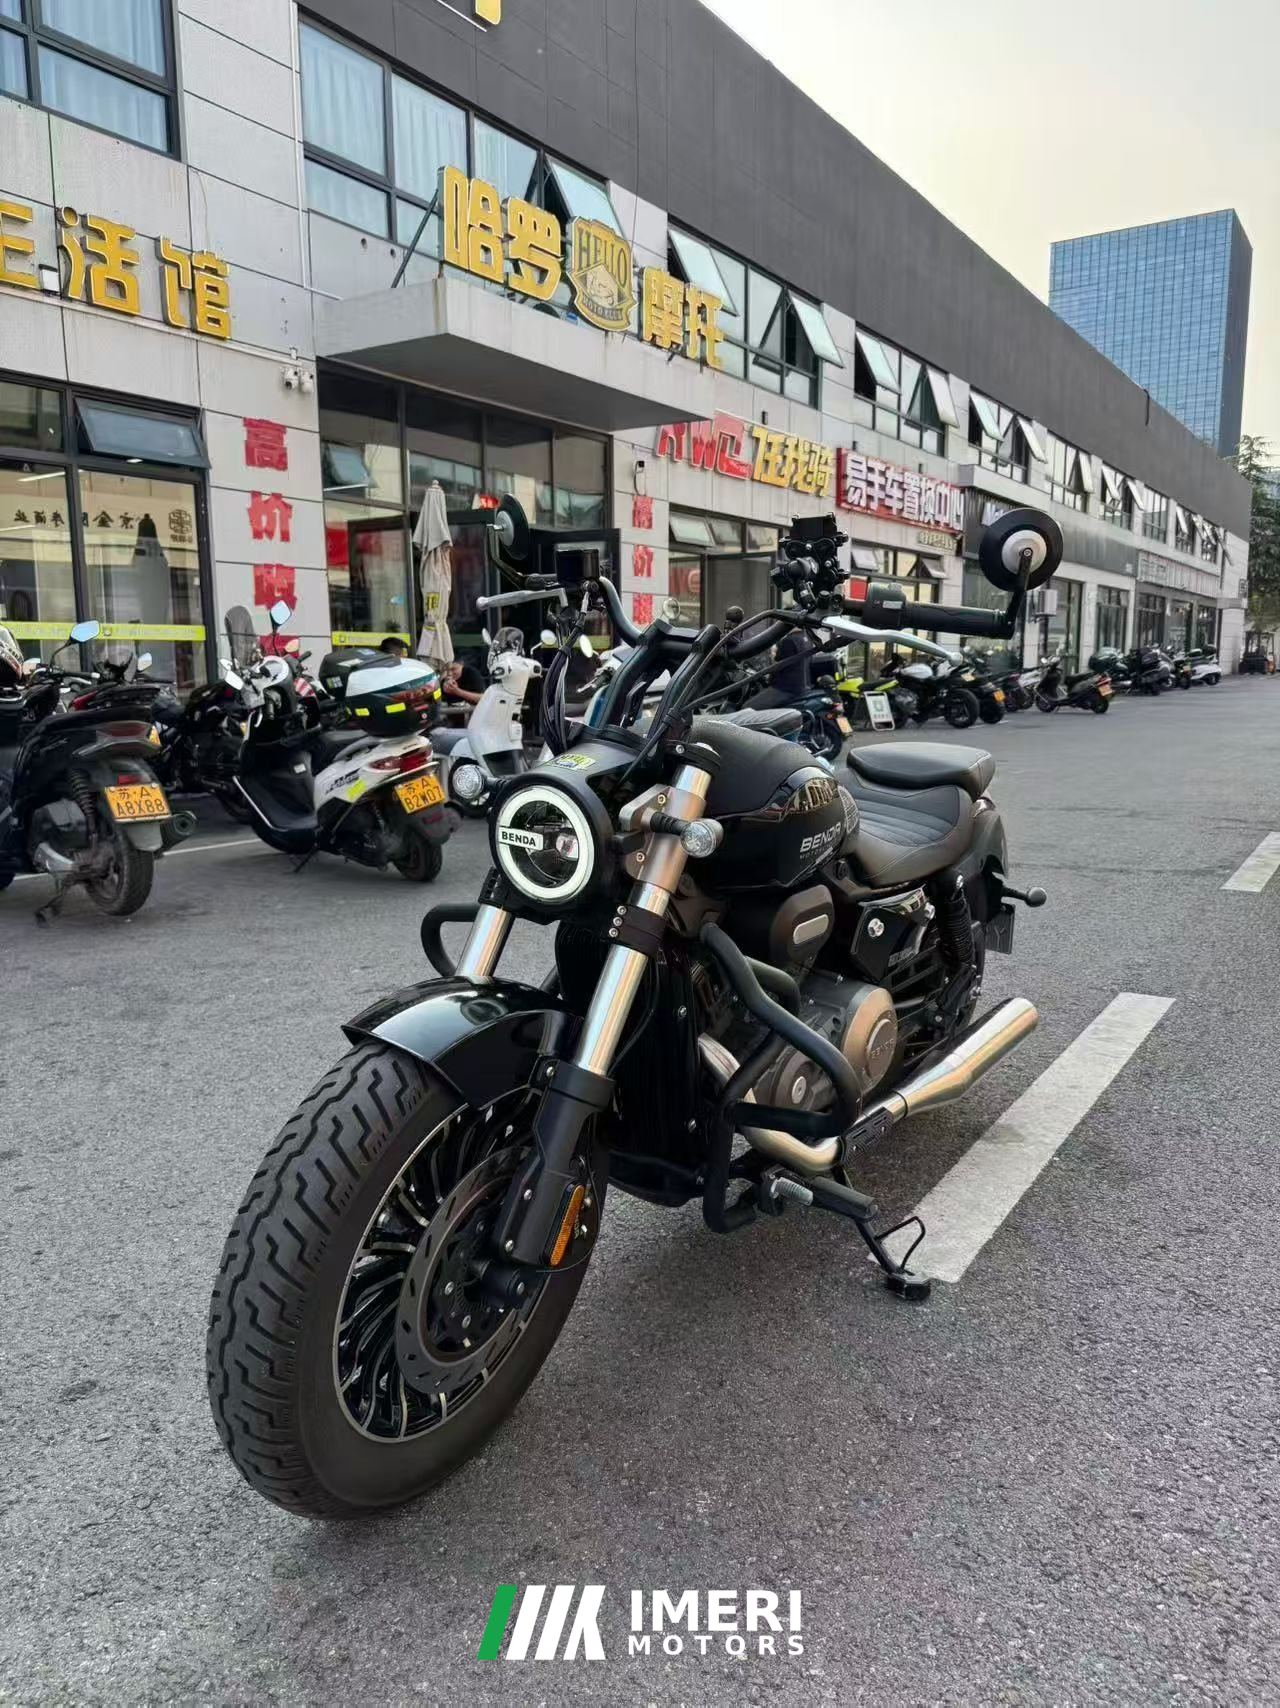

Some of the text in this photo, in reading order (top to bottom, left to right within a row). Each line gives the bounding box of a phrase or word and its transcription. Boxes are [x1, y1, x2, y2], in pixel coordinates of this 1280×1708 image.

[439, 165, 725, 369] 哈罗 摩托
[752, 425, 833, 497] 任我骑
[116, 798, 165, 817] A8X88
[501, 830, 537, 847] BENDA
